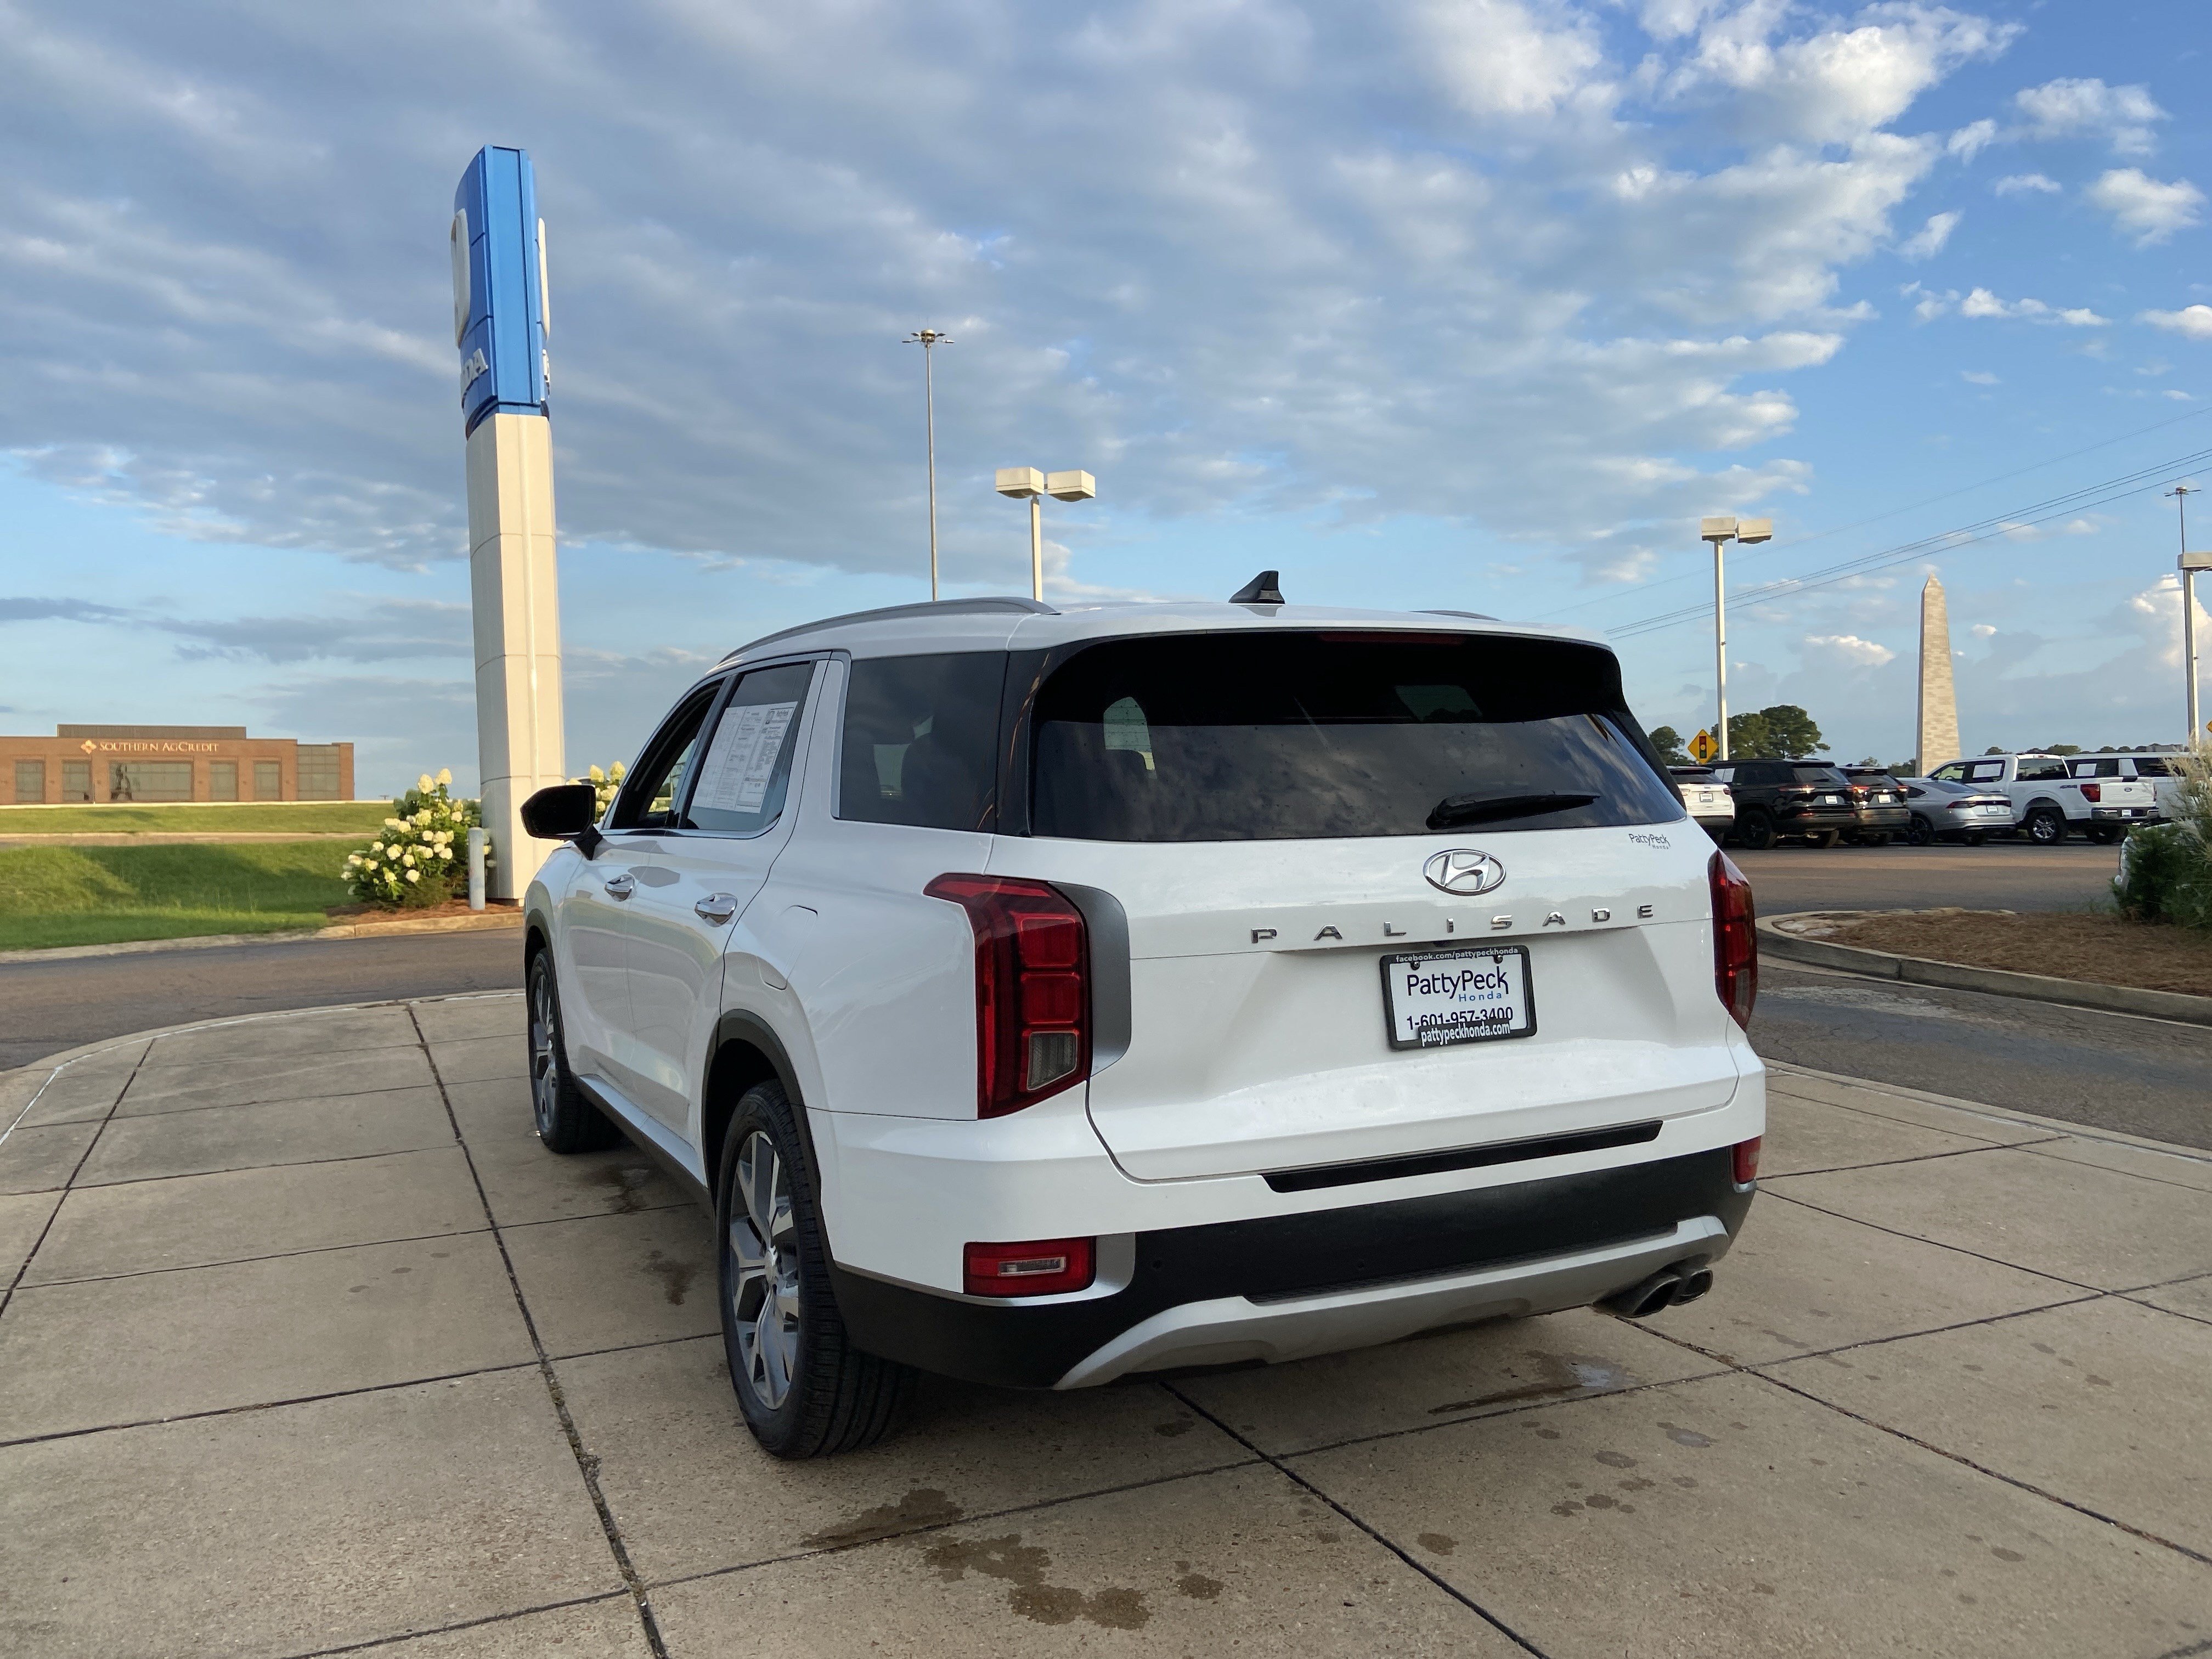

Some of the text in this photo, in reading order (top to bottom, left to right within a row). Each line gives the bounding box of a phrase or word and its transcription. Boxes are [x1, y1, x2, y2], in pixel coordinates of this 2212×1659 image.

[99, 741, 158, 752] SOUTHERN
[1628, 833, 1671, 847] PattyPeck
[1251, 904, 1654, 944] PALISADE
[1396, 946, 1519, 963] facebook.com/pattypeckhonda
[1407, 966, 1509, 999] PattyPeck
[1459, 991, 1502, 1002] Honda
[1407, 1007, 1513, 1030] 1-601-957-3400
[1420, 1021, 1510, 1047] pattypeckhonda.com
